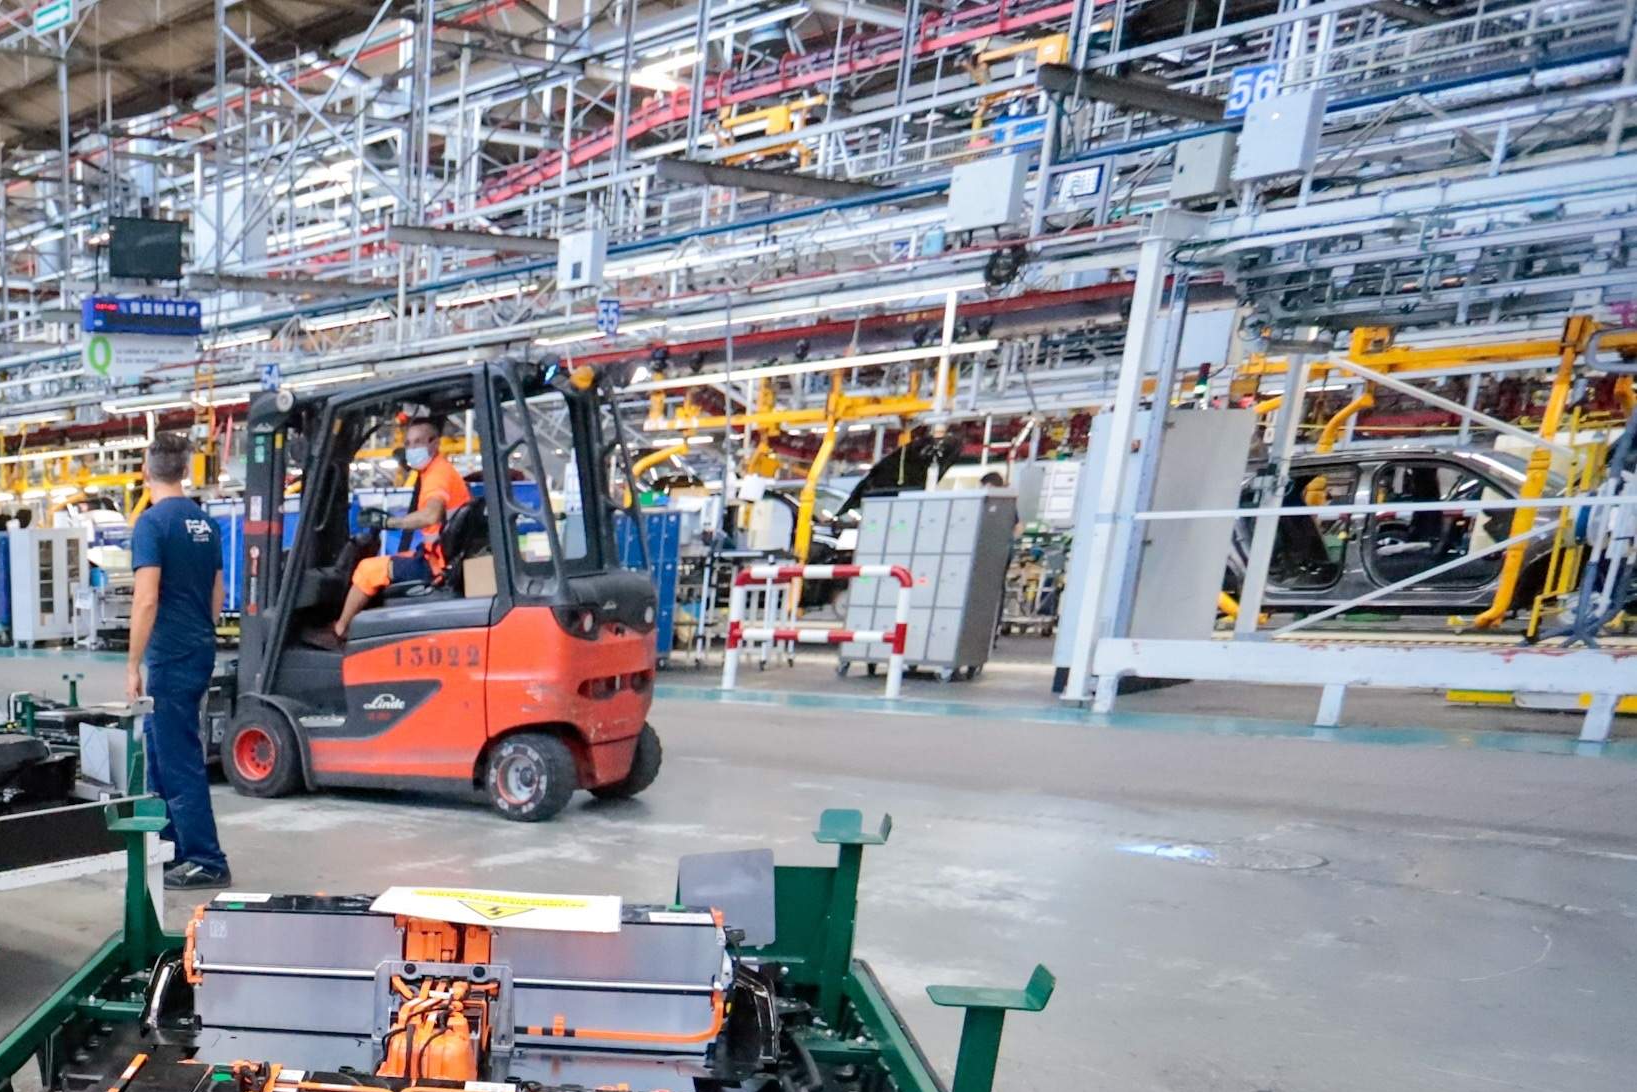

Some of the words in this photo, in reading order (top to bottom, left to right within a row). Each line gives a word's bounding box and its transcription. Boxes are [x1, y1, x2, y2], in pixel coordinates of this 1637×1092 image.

[1229, 69, 1277, 110] 56
[597, 302, 618, 332] 55
[88, 336, 112, 376] Q
[363, 693, 406, 710] Linde
